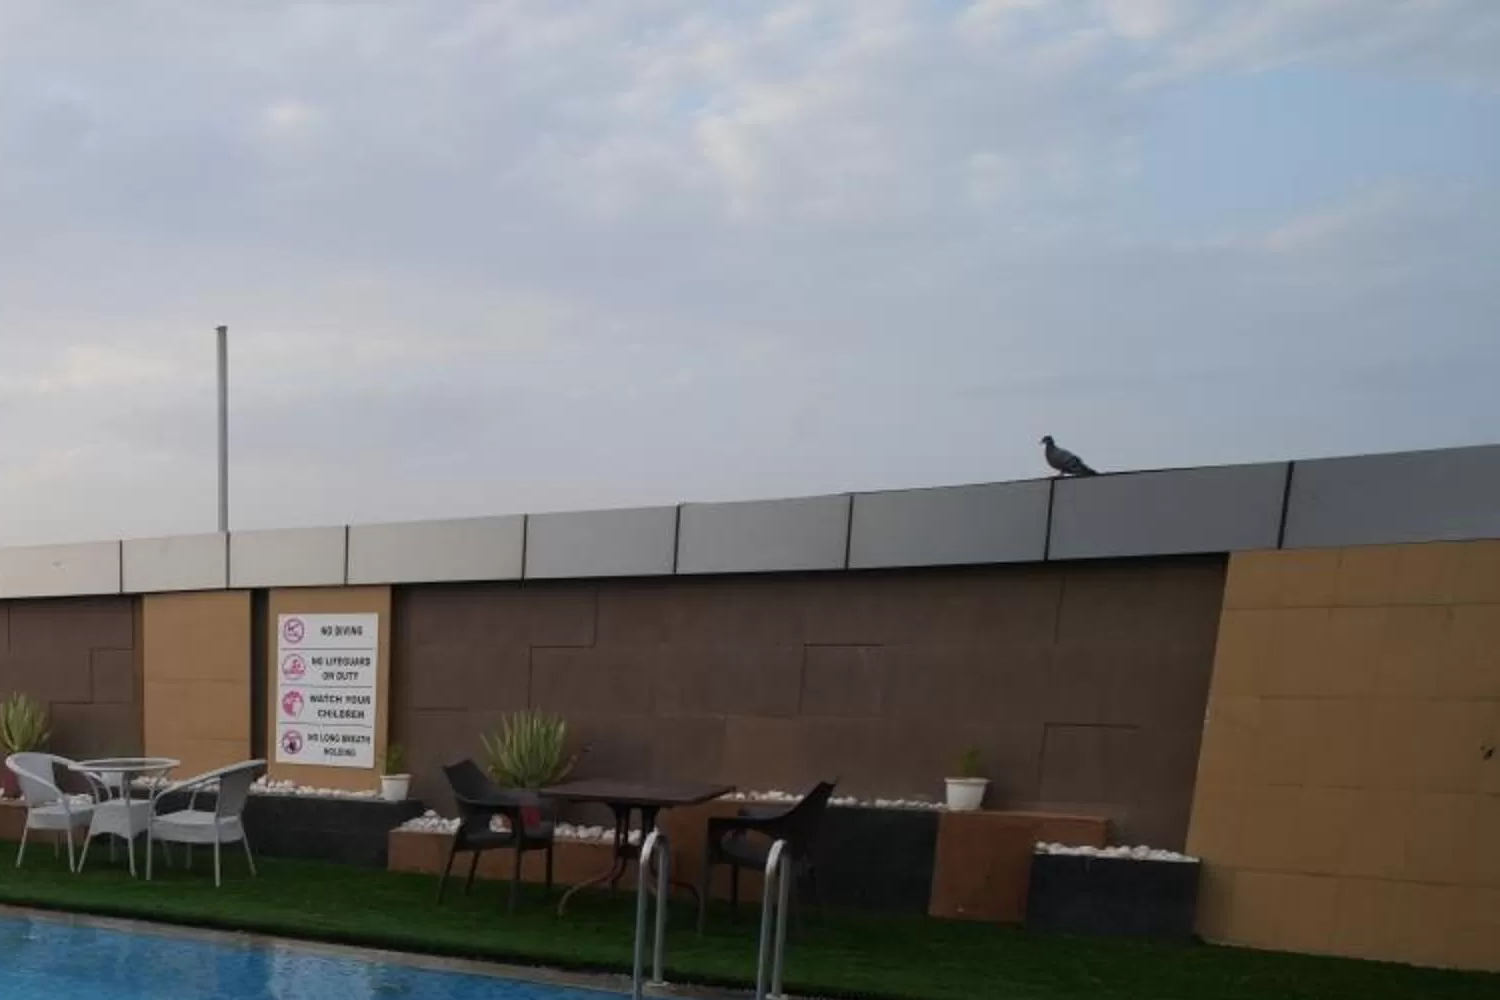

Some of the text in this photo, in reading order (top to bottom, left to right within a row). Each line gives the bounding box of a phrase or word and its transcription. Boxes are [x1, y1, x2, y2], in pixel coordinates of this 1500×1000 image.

[320, 625, 363, 636] NO DIVING
[311, 656, 323, 665] NO
[336, 672, 359, 681] DUTY
[310, 694, 343, 704] WATCH
[317, 709, 365, 719] CHILDREN
